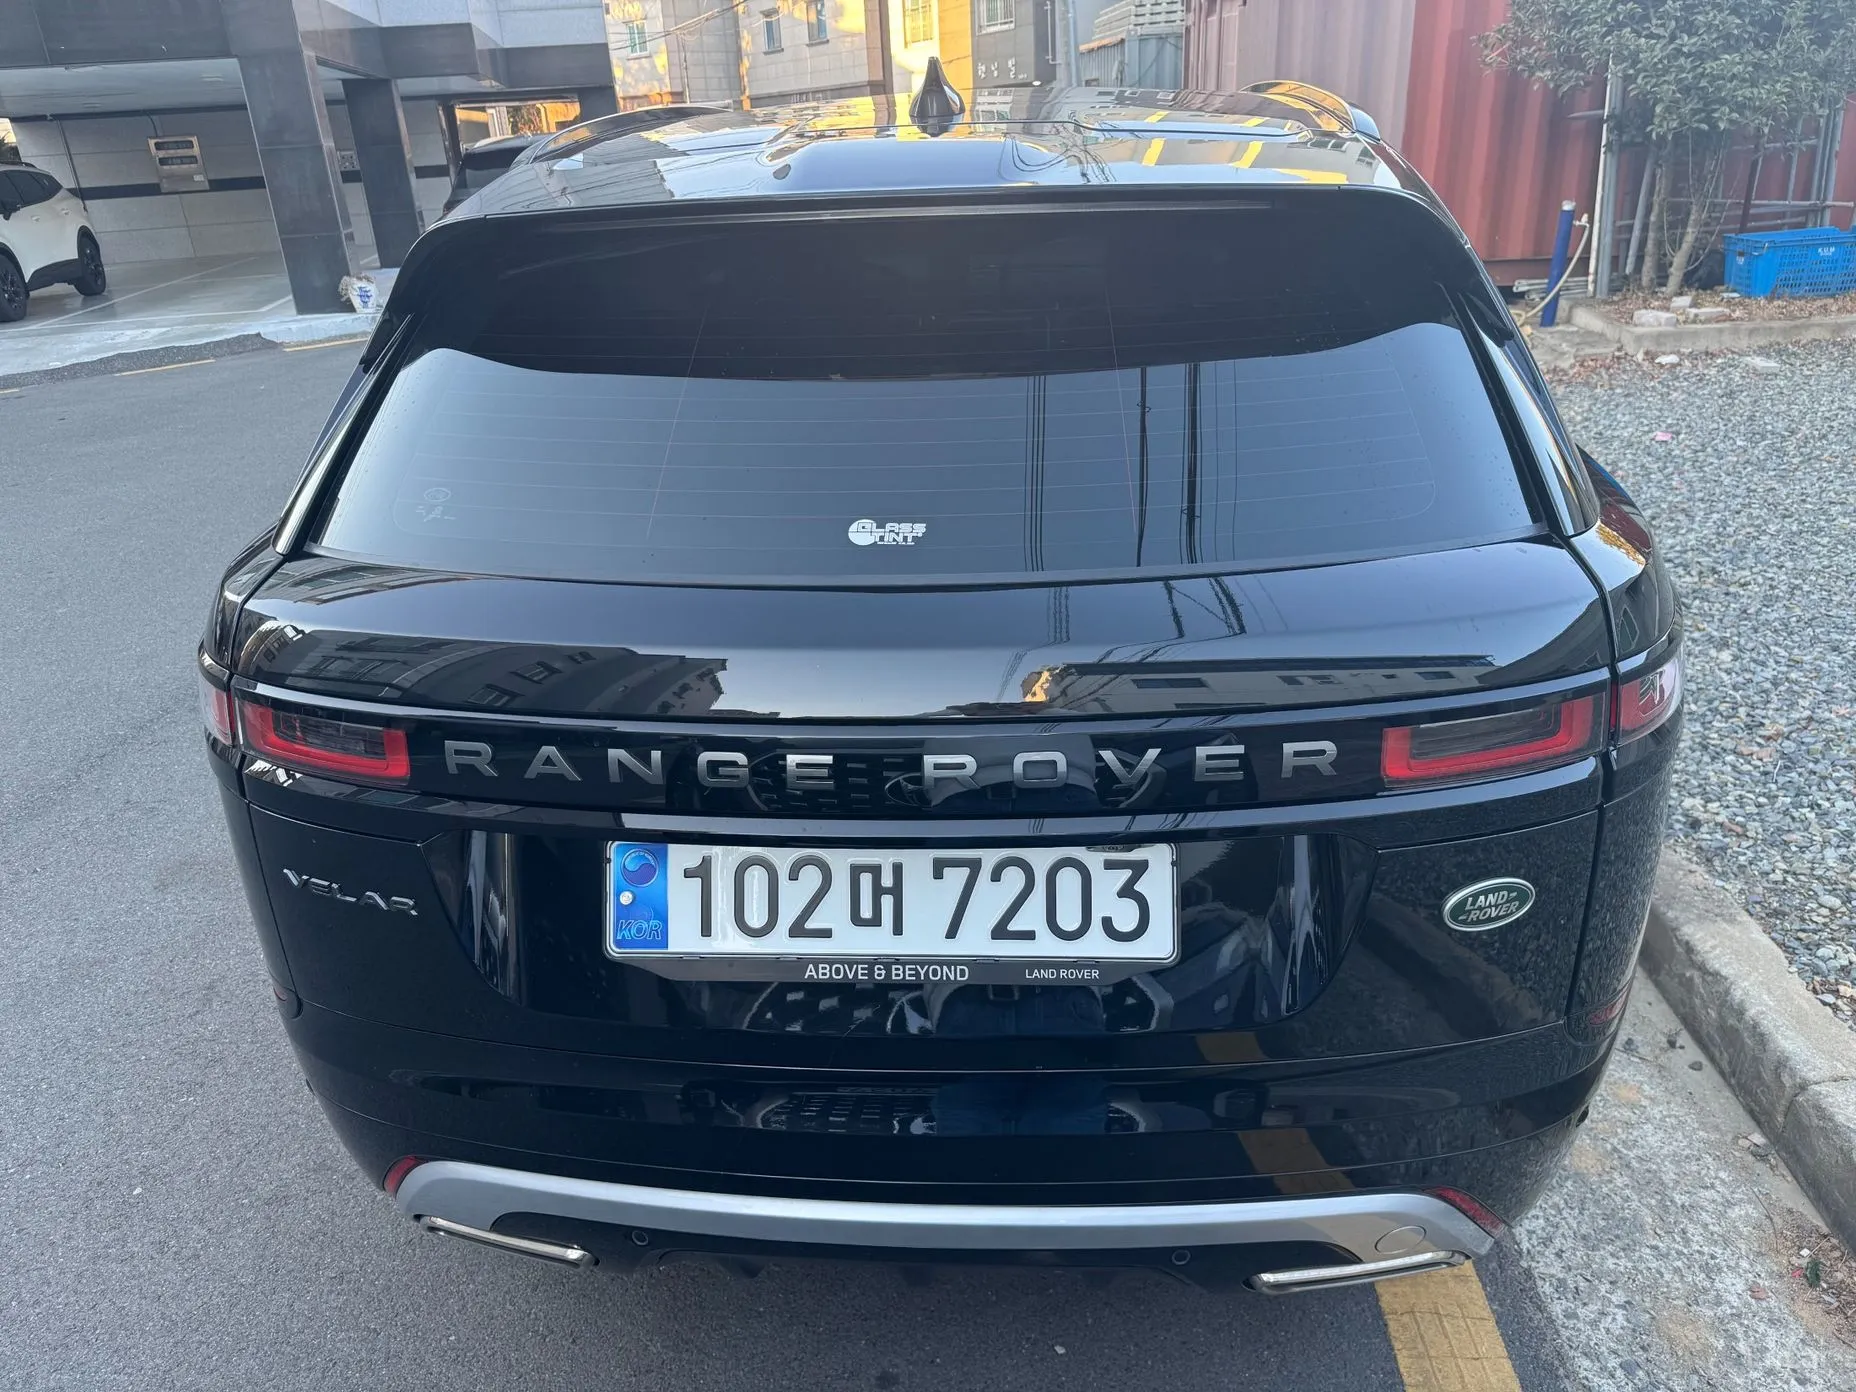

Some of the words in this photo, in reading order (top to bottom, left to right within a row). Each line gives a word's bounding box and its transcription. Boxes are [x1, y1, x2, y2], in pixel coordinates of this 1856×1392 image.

[444, 740, 835, 790] RANGE
[923, 740, 1338, 789] ROVER
[283, 868, 418, 915] VELAR
[684, 855, 903, 938] 102머
[933, 857, 1150, 942] 7203
[1465, 890, 1509, 911] LAND
[1467, 901, 1520, 922] ROVER
[616, 919, 662, 940] KOR
[804, 963, 869, 979] ABOVE
[874, 964, 887, 980] &
[891, 964, 969, 980] BEYOND
[1025, 968, 1057, 979] LAND
[1060, 968, 1100, 980] ROVER
